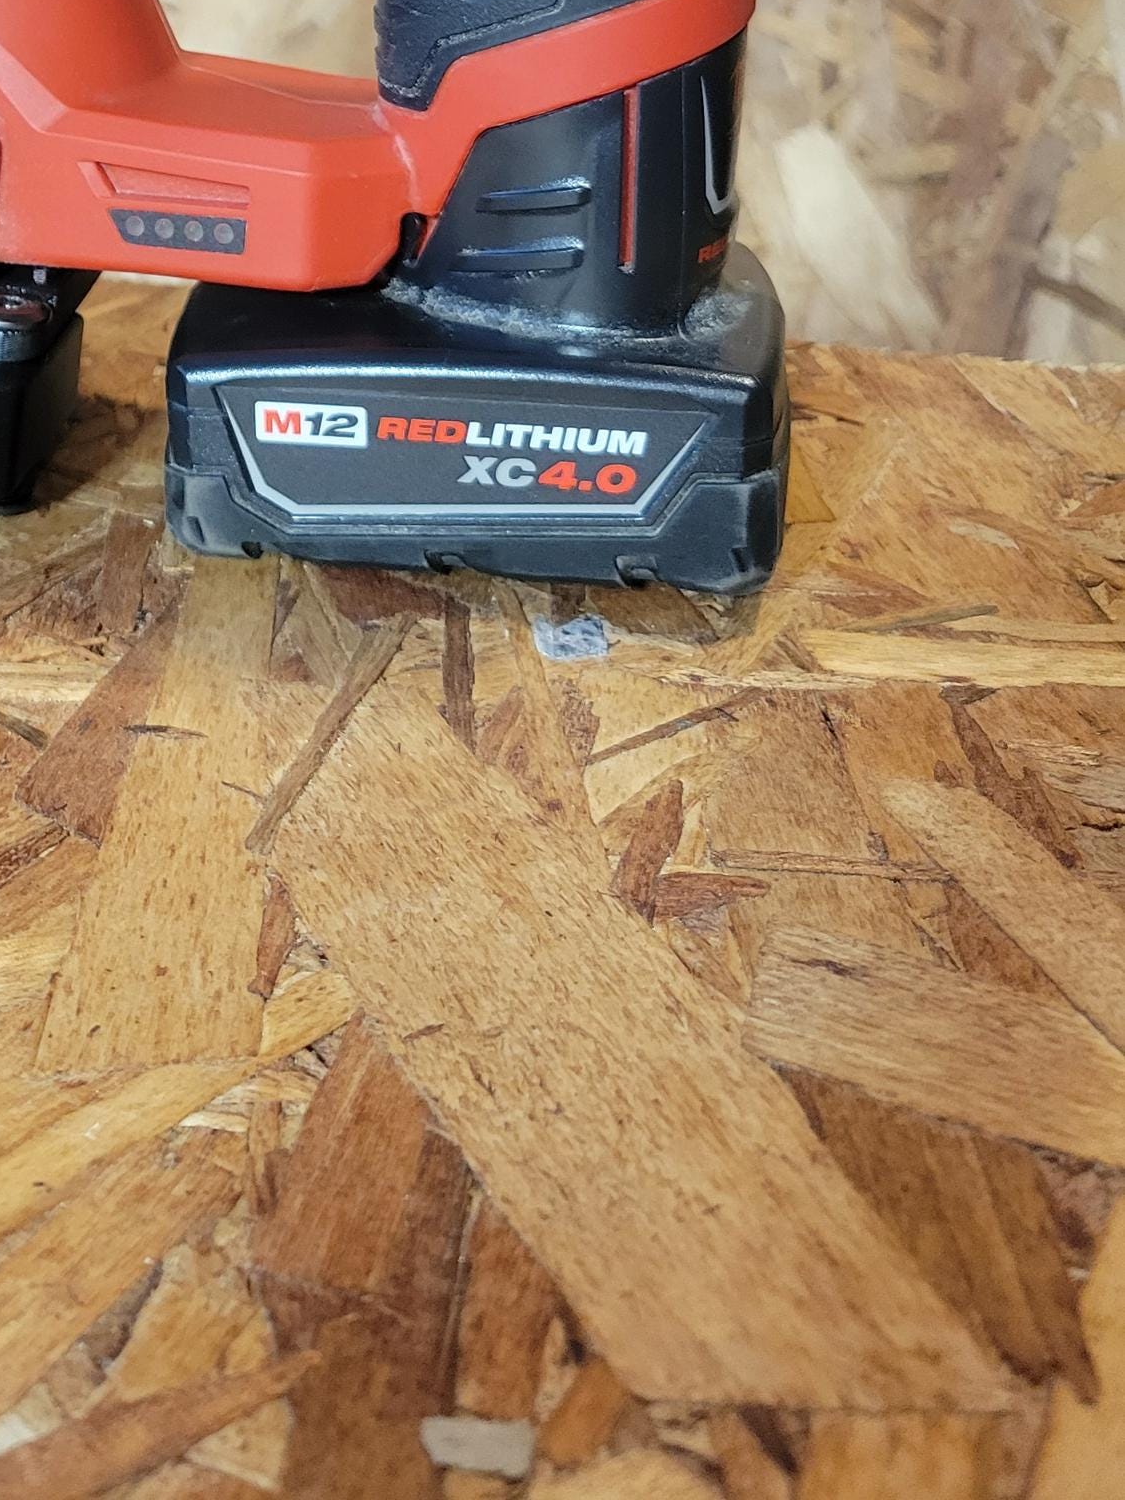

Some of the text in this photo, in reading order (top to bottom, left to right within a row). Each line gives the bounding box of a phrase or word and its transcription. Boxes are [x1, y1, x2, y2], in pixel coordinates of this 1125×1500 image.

[263, 407, 647, 456] M12 REDLITHIUM
[457, 456, 638, 495] XC4.0
